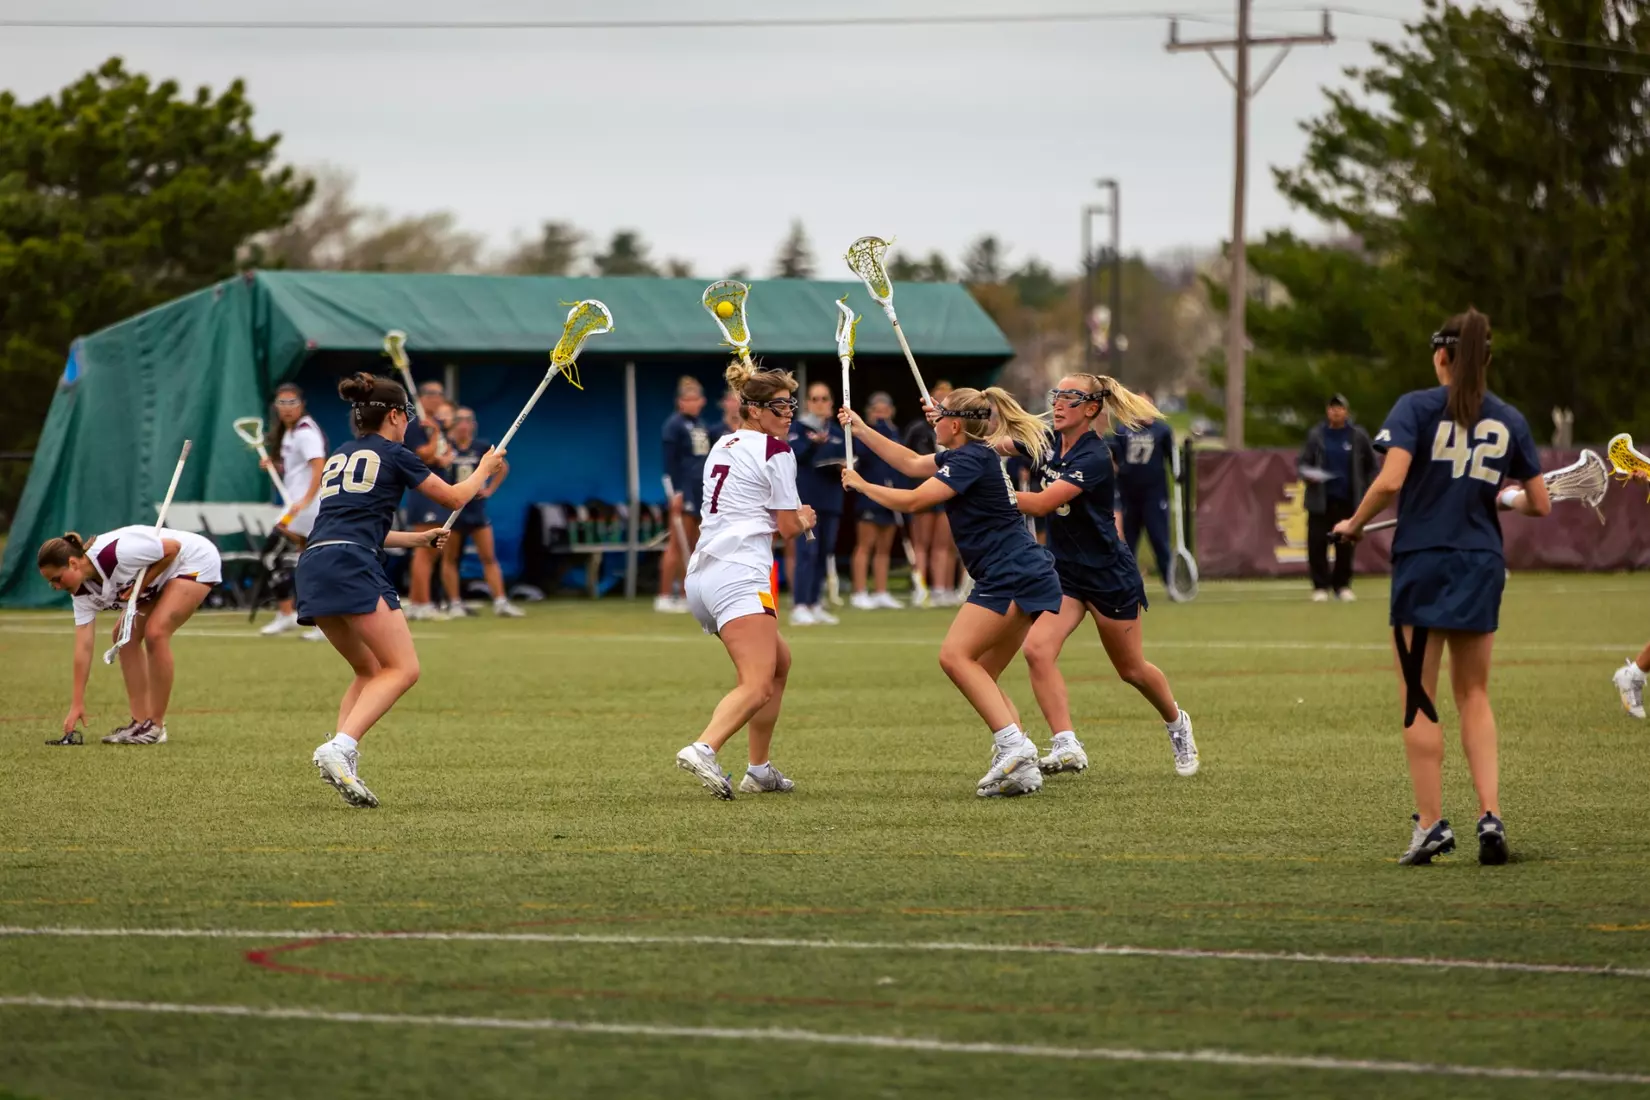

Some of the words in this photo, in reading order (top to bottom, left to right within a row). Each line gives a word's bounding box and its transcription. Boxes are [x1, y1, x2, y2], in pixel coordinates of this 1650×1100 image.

[319, 449, 381, 501] 20
[1040, 464, 1064, 480] AKRO
[1431, 418, 1510, 485] 42
[709, 464, 731, 514] 7
